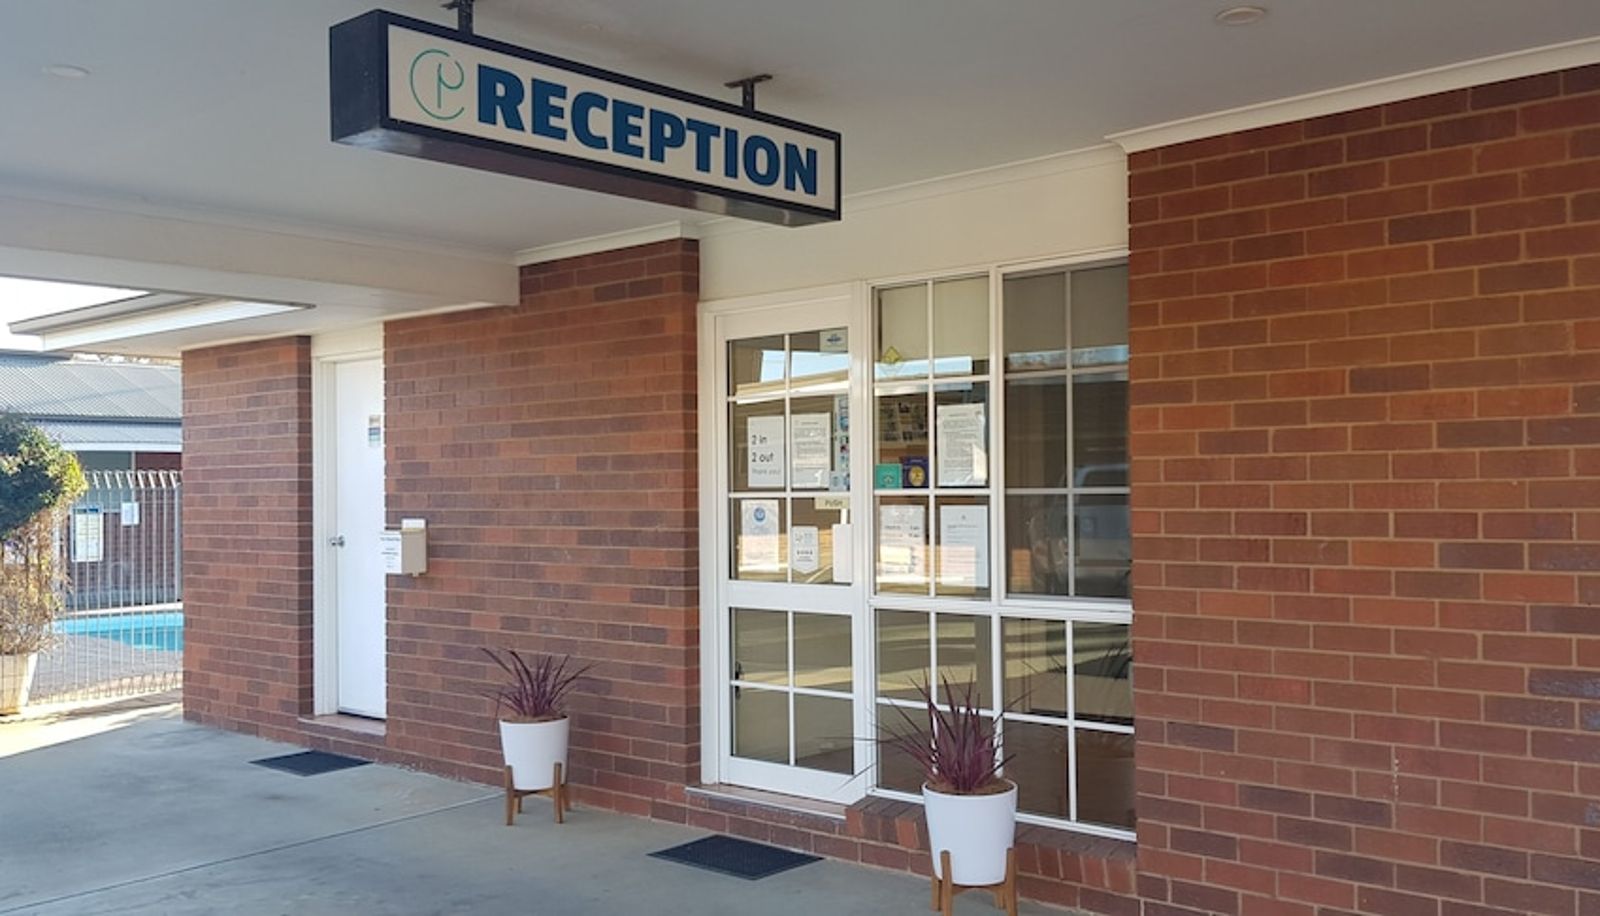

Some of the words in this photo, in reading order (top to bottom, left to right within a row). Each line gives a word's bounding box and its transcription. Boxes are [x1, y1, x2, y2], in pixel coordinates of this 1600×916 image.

[478, 63, 816, 196] RECEPTION
[751, 434, 758, 445] 2
[759, 434, 768, 445] in
[751, 452, 758, 463] 2
[759, 452, 774, 463] out
